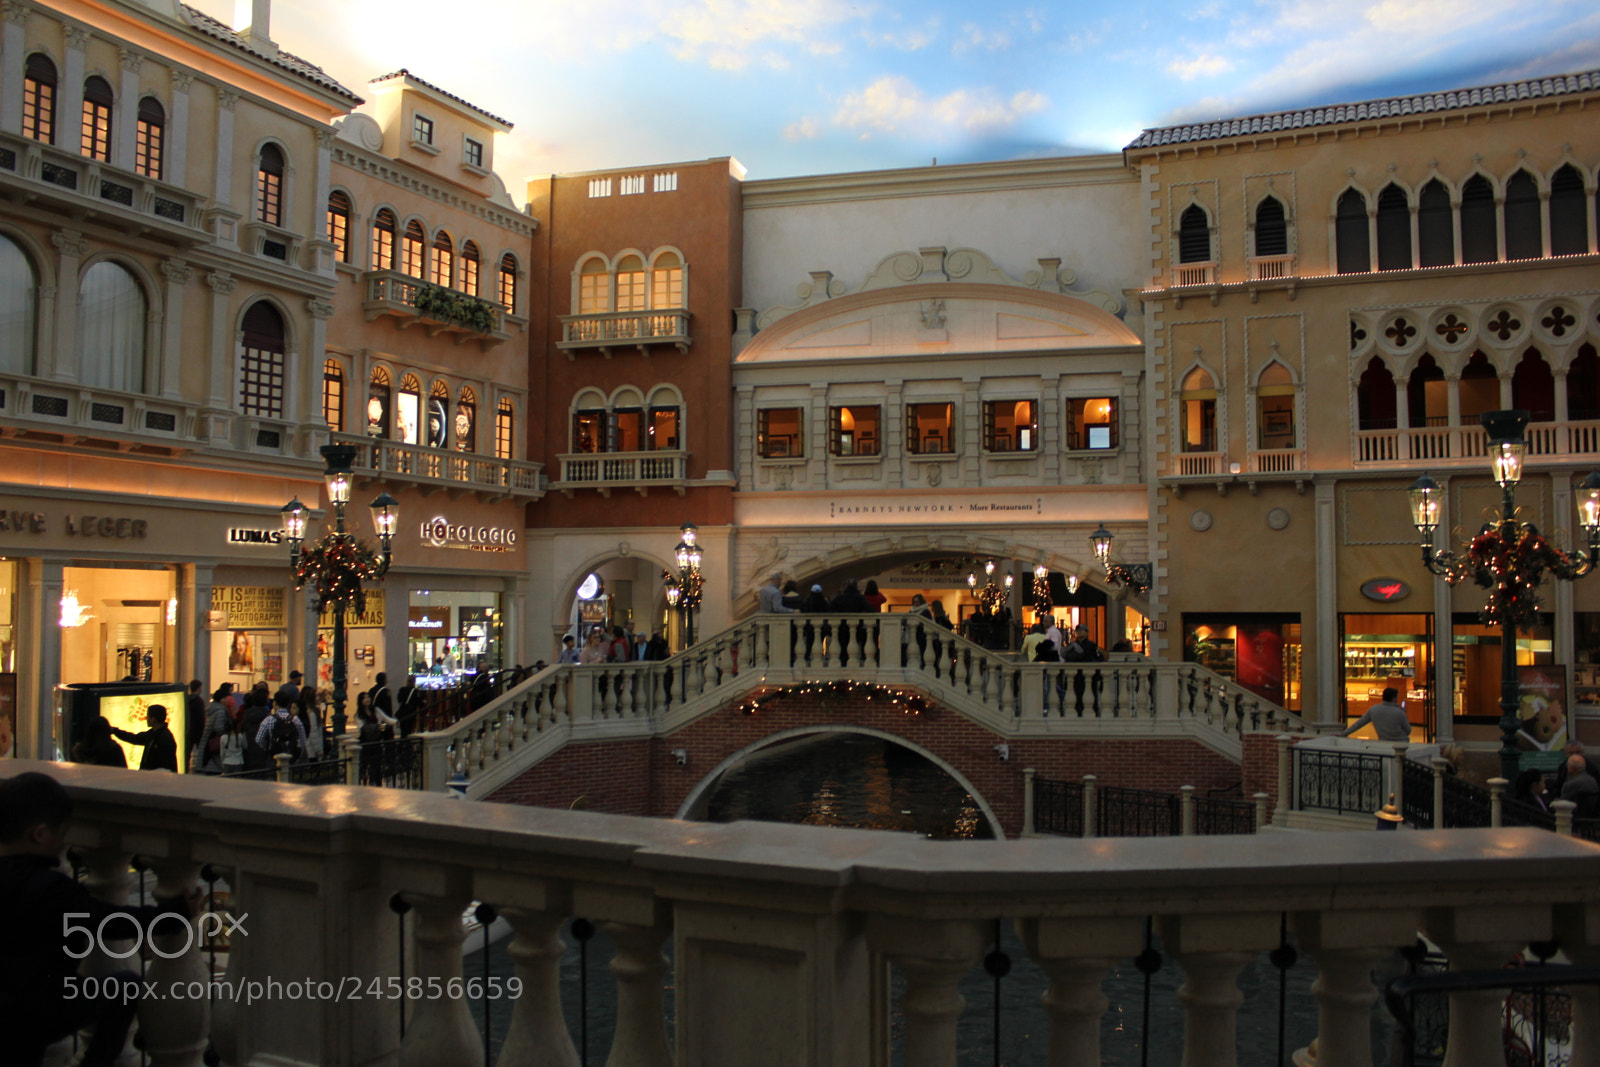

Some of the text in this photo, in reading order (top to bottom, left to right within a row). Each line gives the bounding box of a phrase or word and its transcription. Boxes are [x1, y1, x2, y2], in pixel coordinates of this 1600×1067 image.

[839, 505, 893, 514] BARNEYS
[969, 503, 989, 512] More
[991, 502, 1033, 512] Restaurants
[66, 513, 149, 540] LEGER
[229, 527, 283, 545] LUMAS
[211, 587, 243, 602] RT IS
[244, 588, 257, 596] ART
[244, 600, 257, 608] ART
[228, 612, 284, 621] PHOTOGRAPHY
